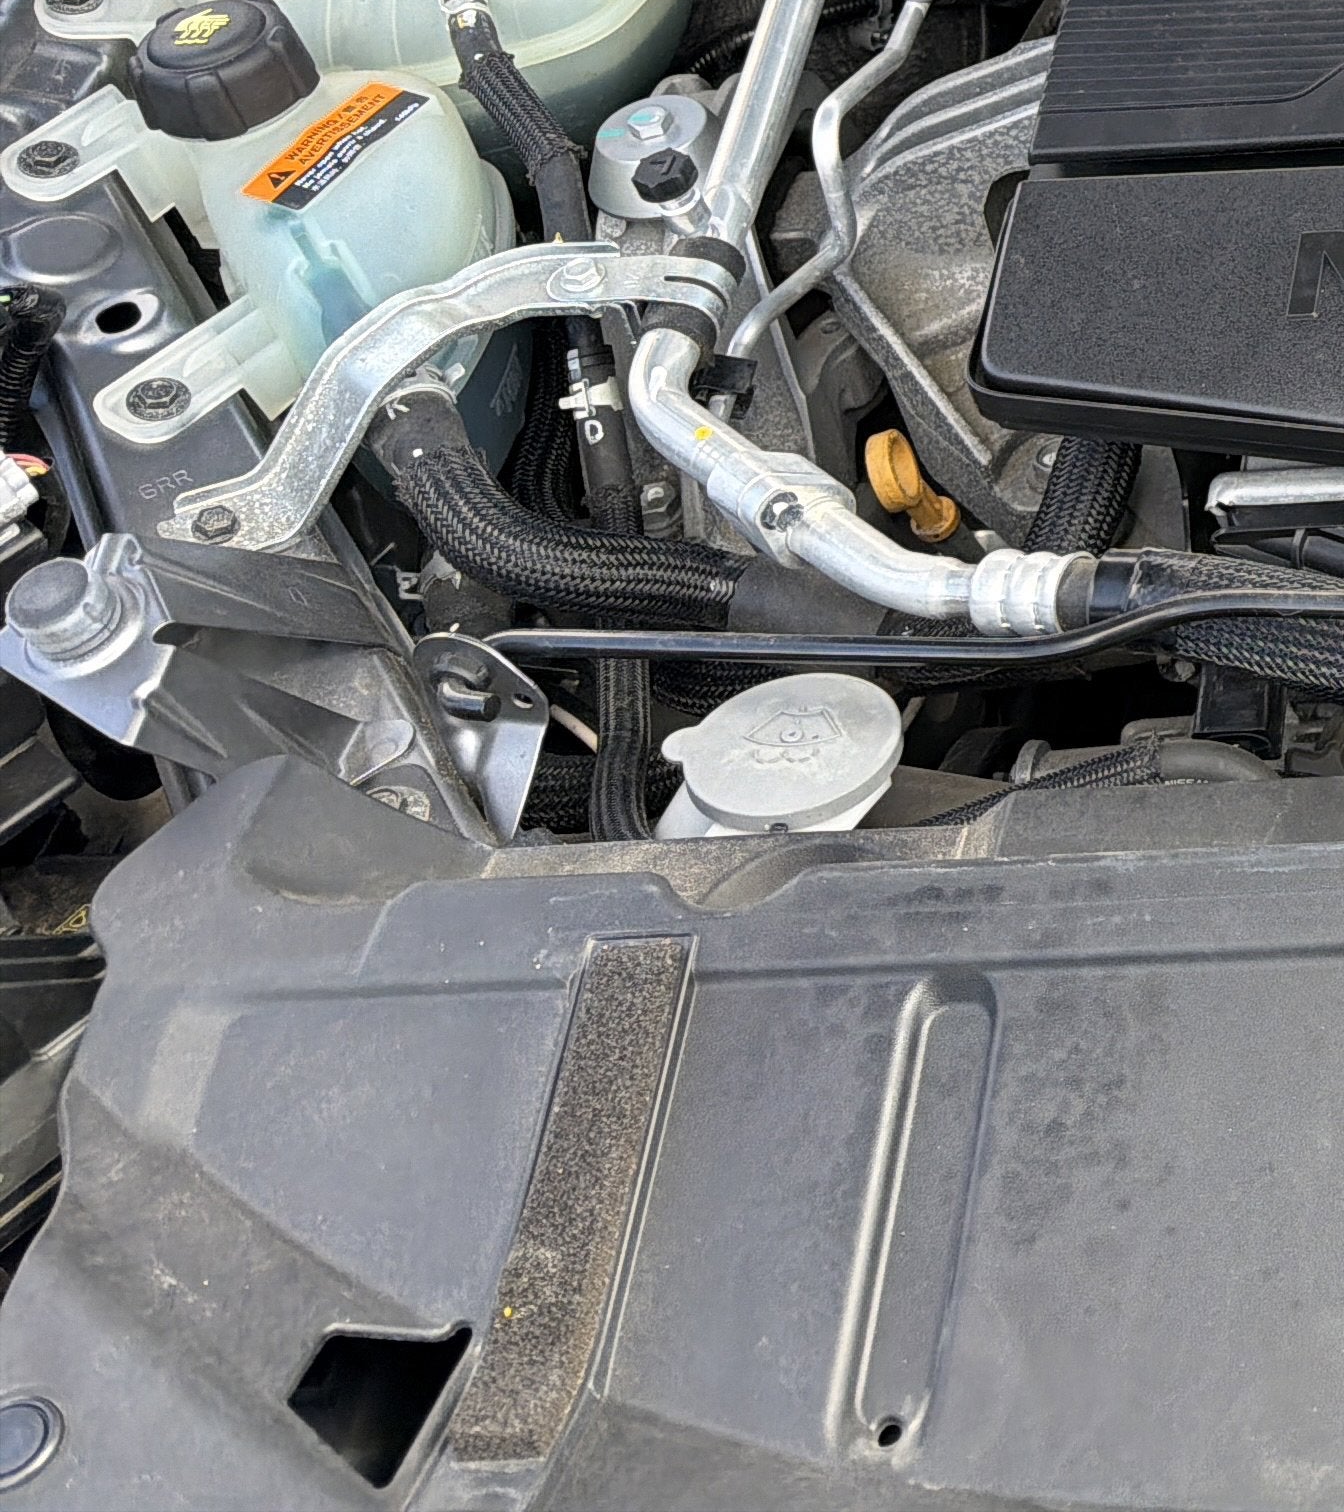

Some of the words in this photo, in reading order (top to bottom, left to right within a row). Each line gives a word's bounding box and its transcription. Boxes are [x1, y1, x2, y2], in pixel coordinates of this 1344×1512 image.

[284, 118, 339, 161] WARNING
[299, 93, 386, 166] AVERTISSEMENT
[139, 470, 194, 499] GRR
